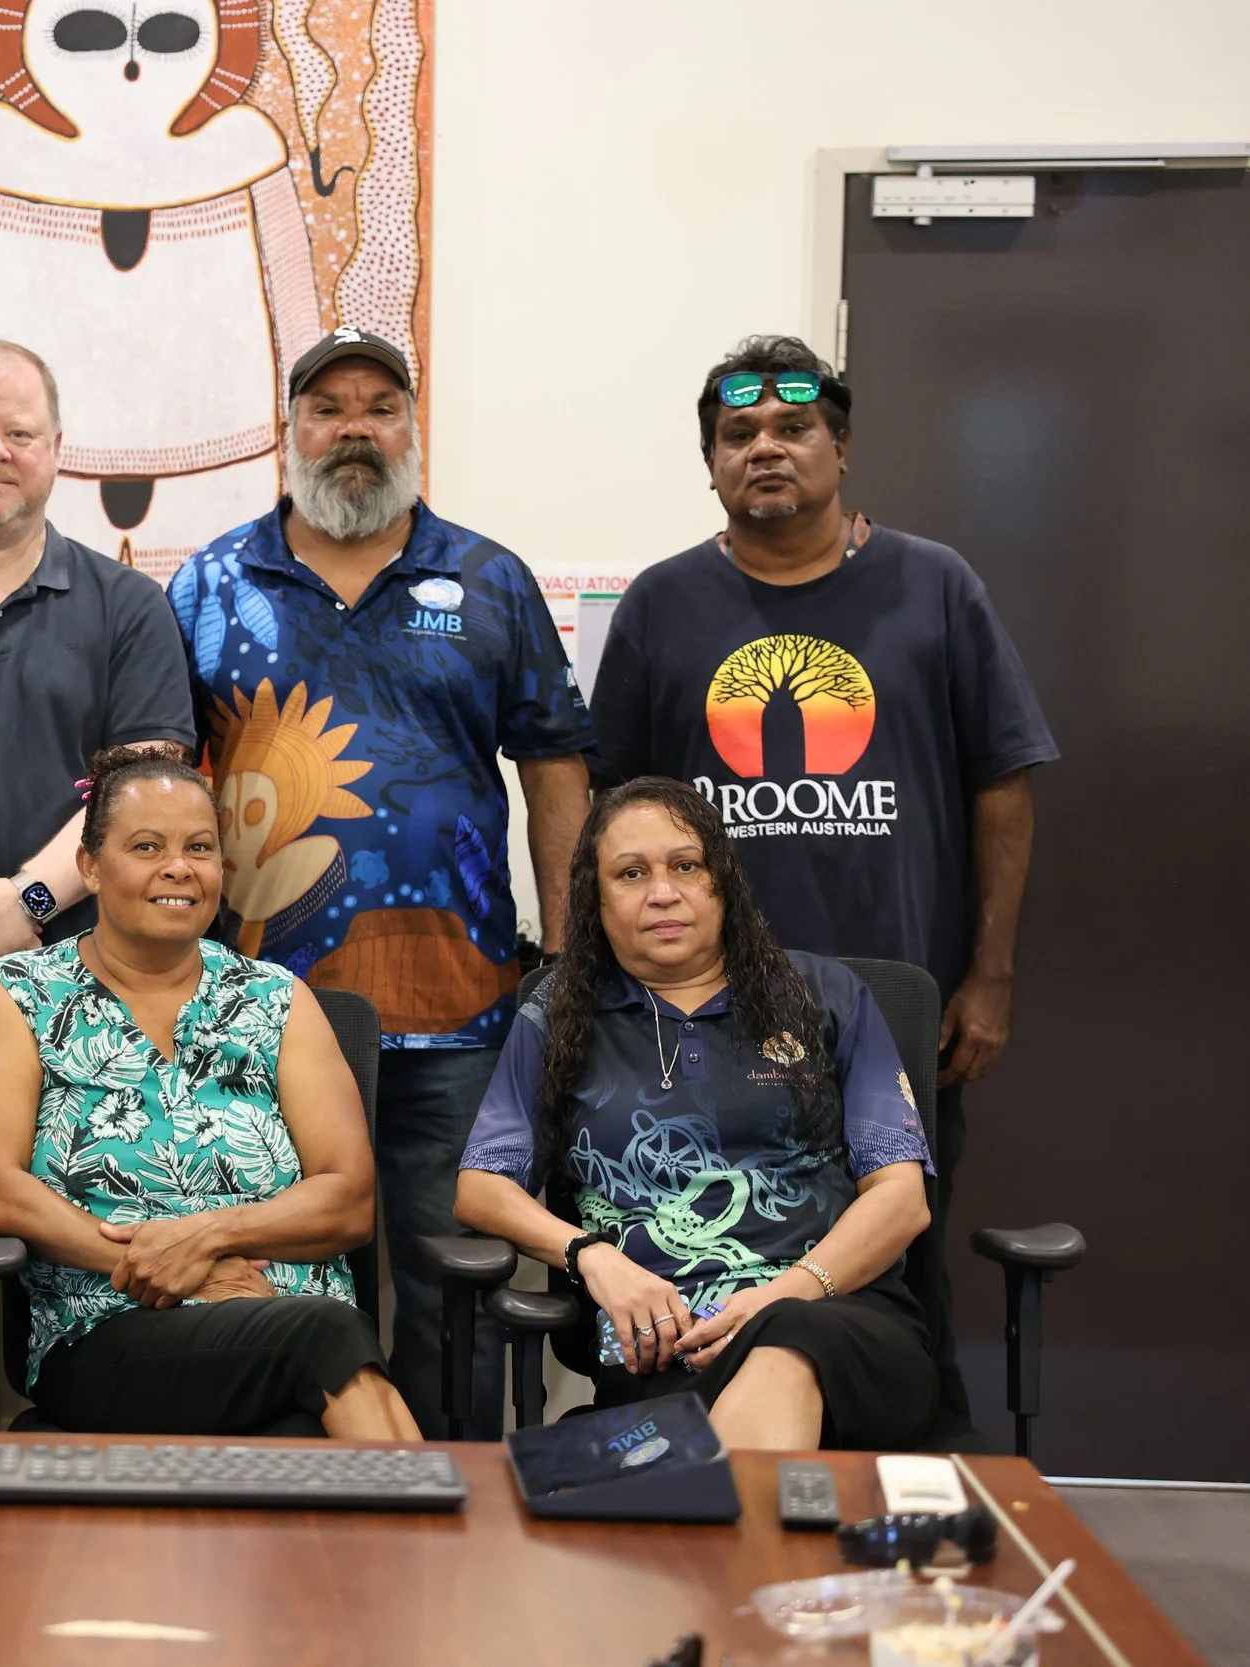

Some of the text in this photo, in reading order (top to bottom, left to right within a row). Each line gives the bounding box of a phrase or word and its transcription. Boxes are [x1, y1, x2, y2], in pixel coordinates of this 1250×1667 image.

[407, 610, 463, 633] JMB
[725, 821, 892, 839] WESTERN AUSTRALIA
